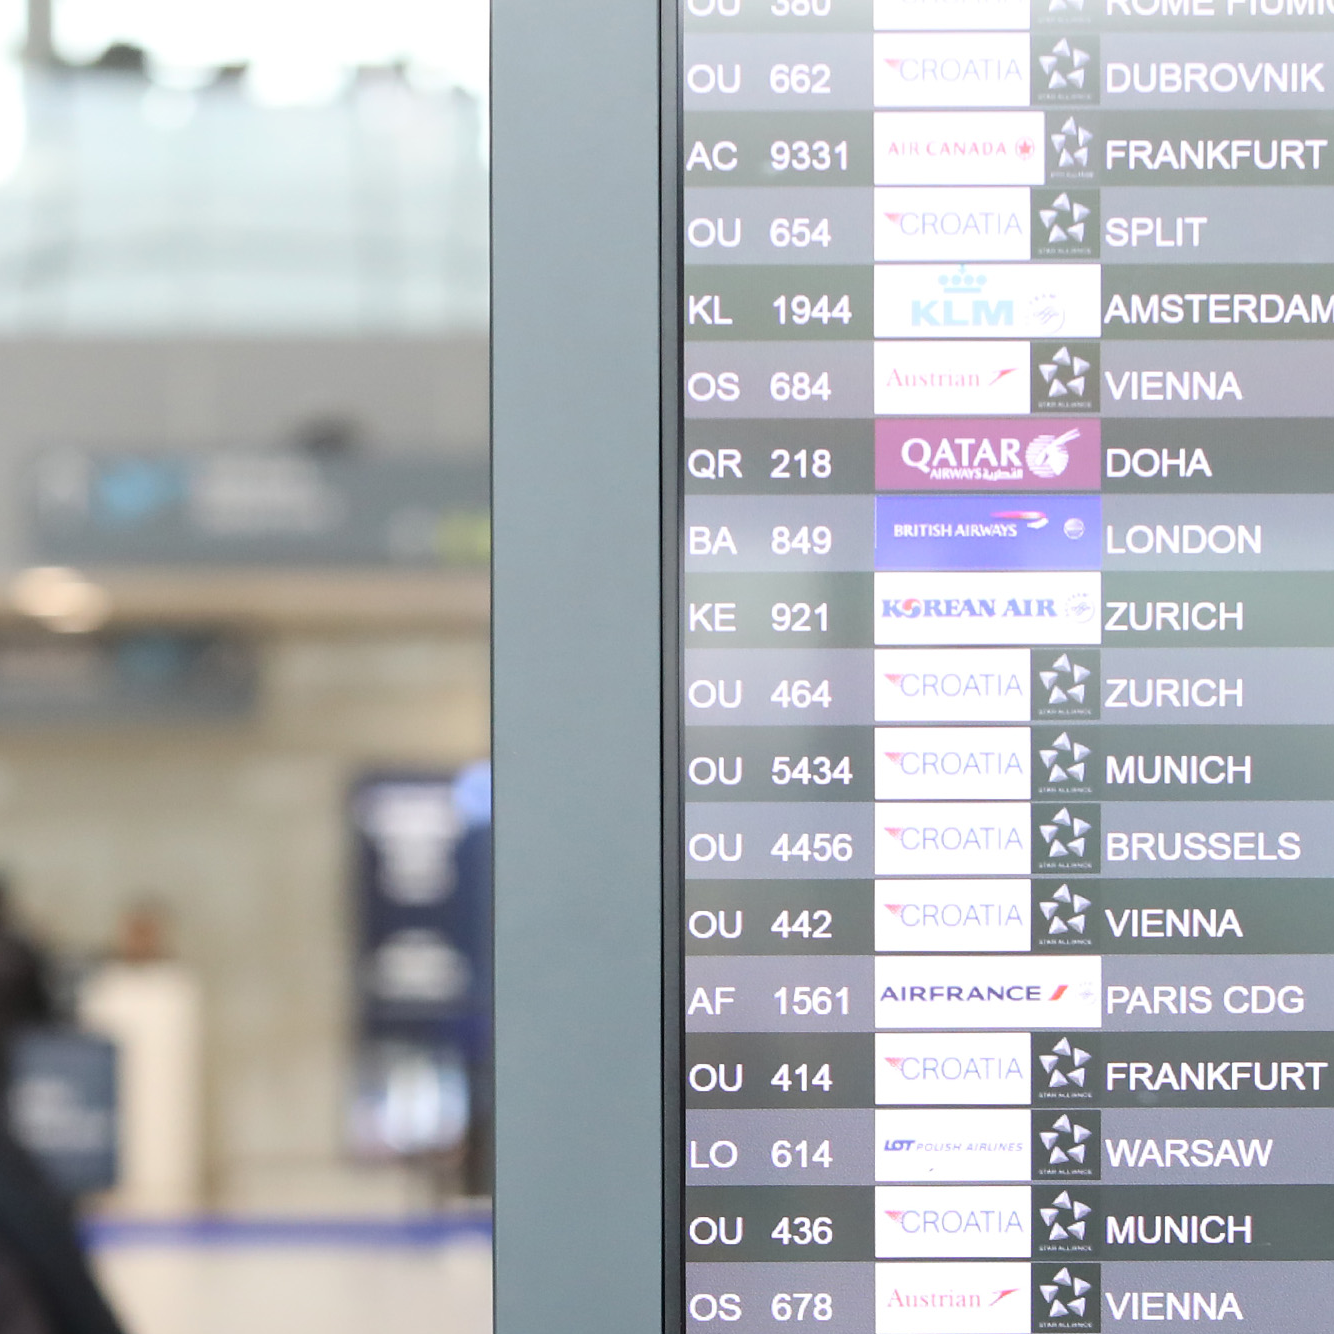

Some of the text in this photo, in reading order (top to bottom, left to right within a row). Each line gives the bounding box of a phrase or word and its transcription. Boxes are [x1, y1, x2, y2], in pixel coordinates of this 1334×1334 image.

[687, 64, 741, 94] OU
[769, 63, 831, 94] 662
[1106, 62, 1325, 93] DUBROVNIK
[685, 140, 738, 171] AC
[770, 140, 847, 171] 9331
[1106, 139, 1329, 170] FRANKFURT
[888, 142, 1007, 156] AIR CANADA
[687, 217, 741, 248] OU
[769, 218, 832, 248] 654
[1105, 216, 1208, 247] SPLIT
[900, 212, 1023, 236] CROATIA
[688, 295, 733, 325] KL
[773, 294, 853, 325] 1944
[911, 299, 1014, 327] KLM
[687, 372, 741, 401] OS
[770, 371, 832, 401] 684
[1104, 371, 1243, 401] VIENNA
[886, 368, 980, 387] Austrian
[687, 448, 743, 480] QR
[770, 448, 832, 479] 218
[1106, 448, 1213, 478] DOHA
[901, 437, 1023, 474] QATAR
[930, 468, 982, 480] AIRWAYS
[689, 526, 738, 555] BA
[771, 525, 832, 555] 849
[1106, 524, 1262, 554] LONDON
[893, 524, 1018, 537] BRITISH AIRWAYS
[689, 602, 737, 632] KE
[771, 602, 828, 632] 921
[1104, 601, 1244, 631] ZURICH
[1001, 598, 1058, 617] AIR
[688, 679, 742, 709] OU
[770, 679, 832, 709] 464
[1104, 678, 1243, 708] ZURICH
[688, 756, 742, 785] OU
[771, 756, 853, 785] 5434
[1106, 755, 1251, 784] MUNICH
[688, 833, 742, 862] OU
[770, 833, 853, 862] 4456
[1107, 831, 1301, 861] BRUSSELS
[687, 986, 736, 1015] AF
[774, 986, 849, 1015] 1561
[1107, 985, 1213, 1015] PARIS
[1223, 985, 1304, 1014] CDG
[689, 1063, 743, 1092] OU
[770, 1063, 833, 1092] 414
[1106, 1061, 1329, 1091] FRANKFURT
[901, 1057, 1024, 1080] CROATIA
[690, 1140, 738, 1168] LO
[771, 1139, 834, 1168] 614
[1104, 1138, 1274, 1168] WARSAW
[883, 1139, 916, 1152] LOT
[689, 1216, 743, 1245] OU
[771, 1216, 833, 1245] 436
[1107, 1215, 1252, 1244] MUNICH
[689, 1293, 742, 1322] OS
[771, 1292, 833, 1321] 678
[1104, 1292, 1244, 1321] VIENNA
[887, 1288, 981, 1308] Austrian
